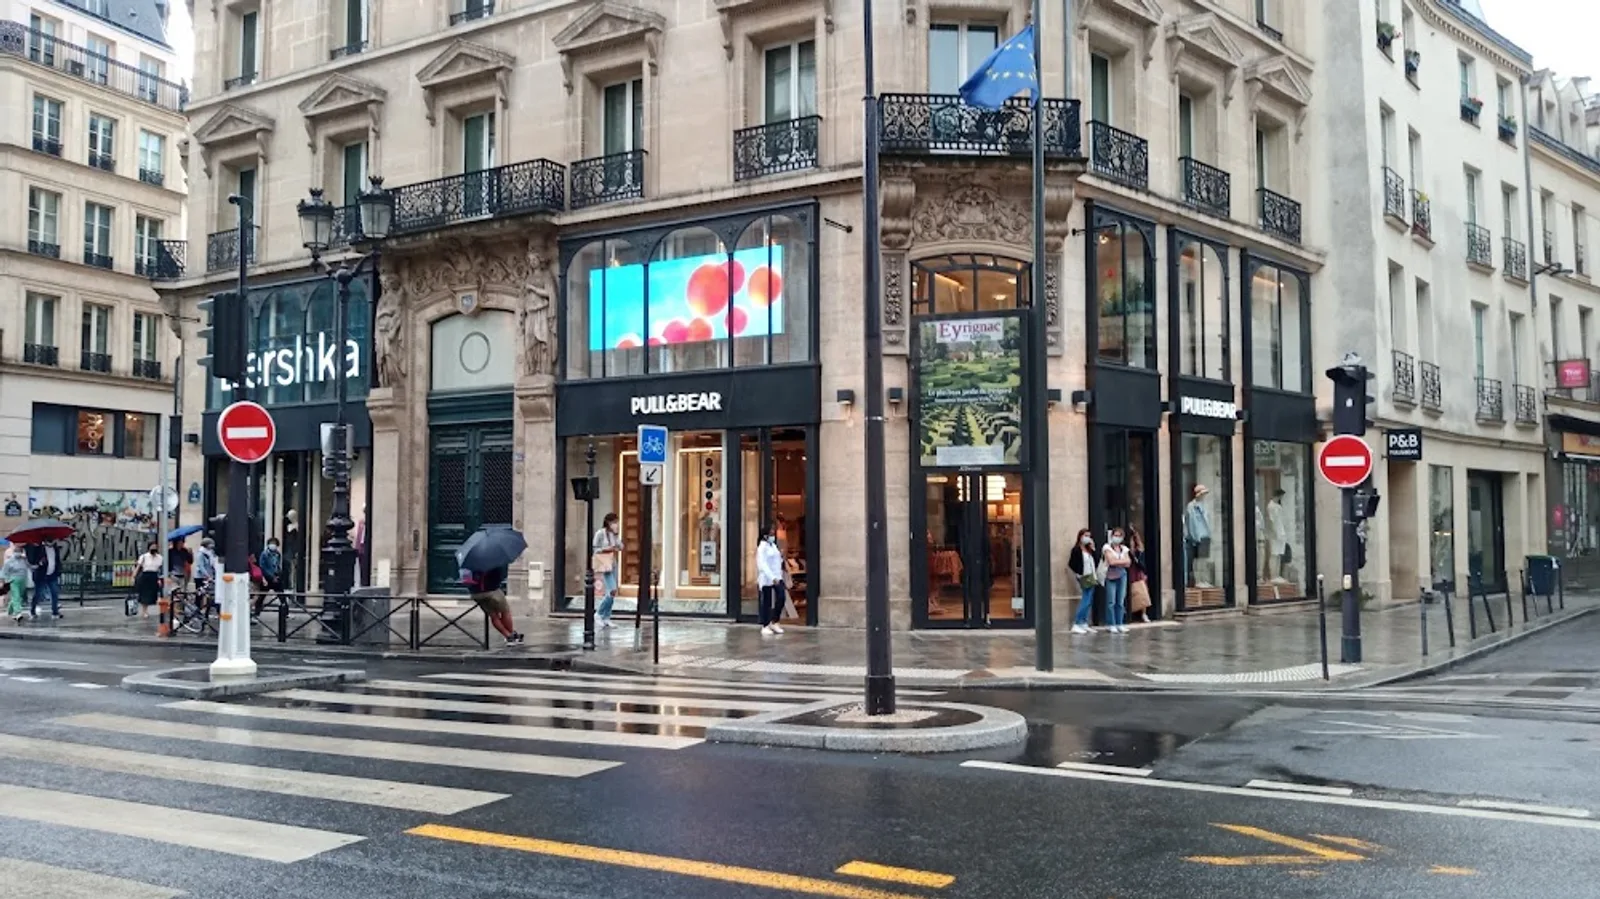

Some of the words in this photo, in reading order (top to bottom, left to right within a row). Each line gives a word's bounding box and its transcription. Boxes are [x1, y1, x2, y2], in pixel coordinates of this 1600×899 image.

[939, 321, 1001, 341] Eyrignac
[221, 331, 360, 391] ershka
[631, 392, 722, 415] PULL&BEAR
[1181, 396, 1237, 419] PULL&BEAR
[1389, 434, 1419, 448] P&B
